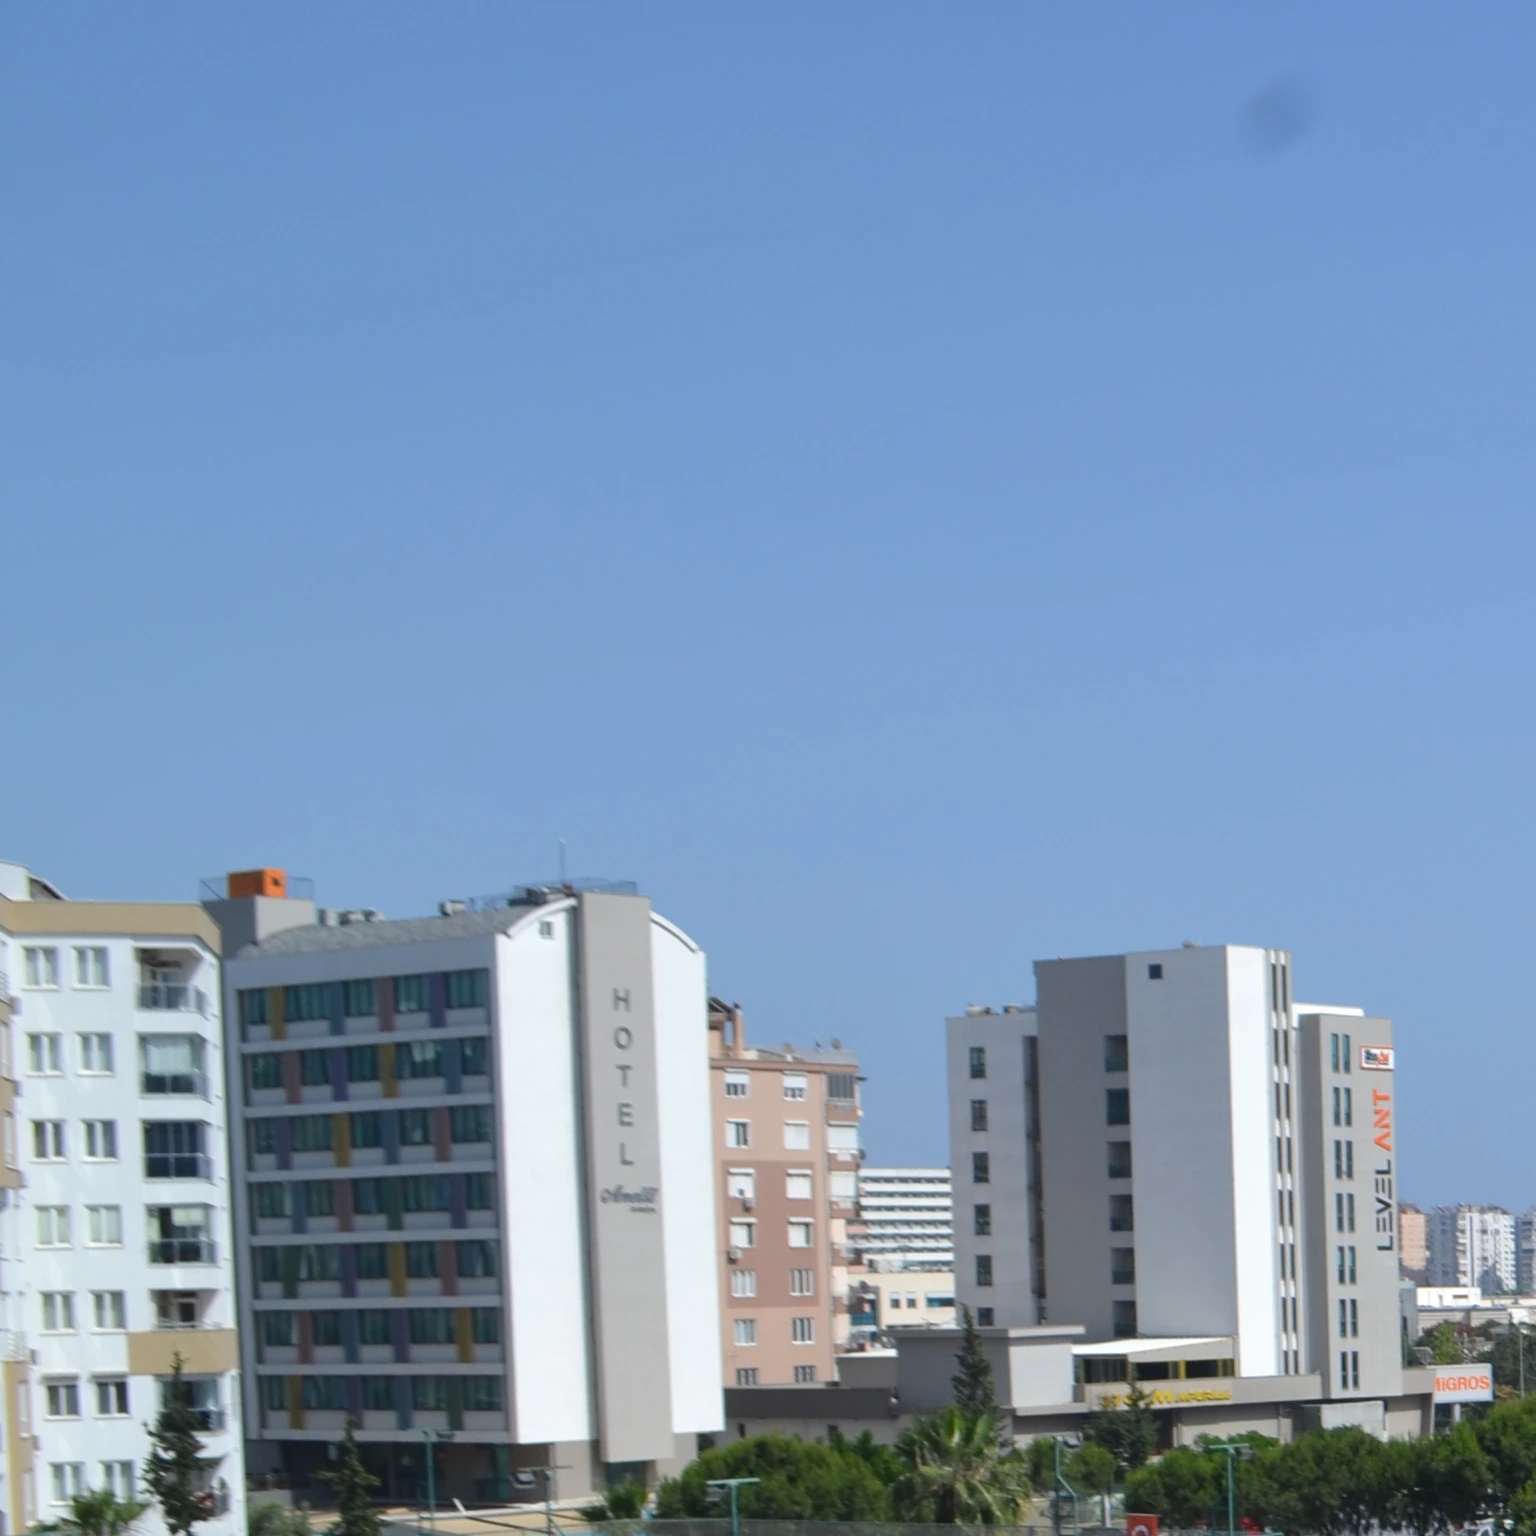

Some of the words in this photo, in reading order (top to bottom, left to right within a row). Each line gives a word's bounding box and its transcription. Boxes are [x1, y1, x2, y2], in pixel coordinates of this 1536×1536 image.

[613, 987, 635, 1167] HOTEL
[1372, 1088, 1392, 1152] ANT
[1374, 1159, 1394, 1251] LEVEL
